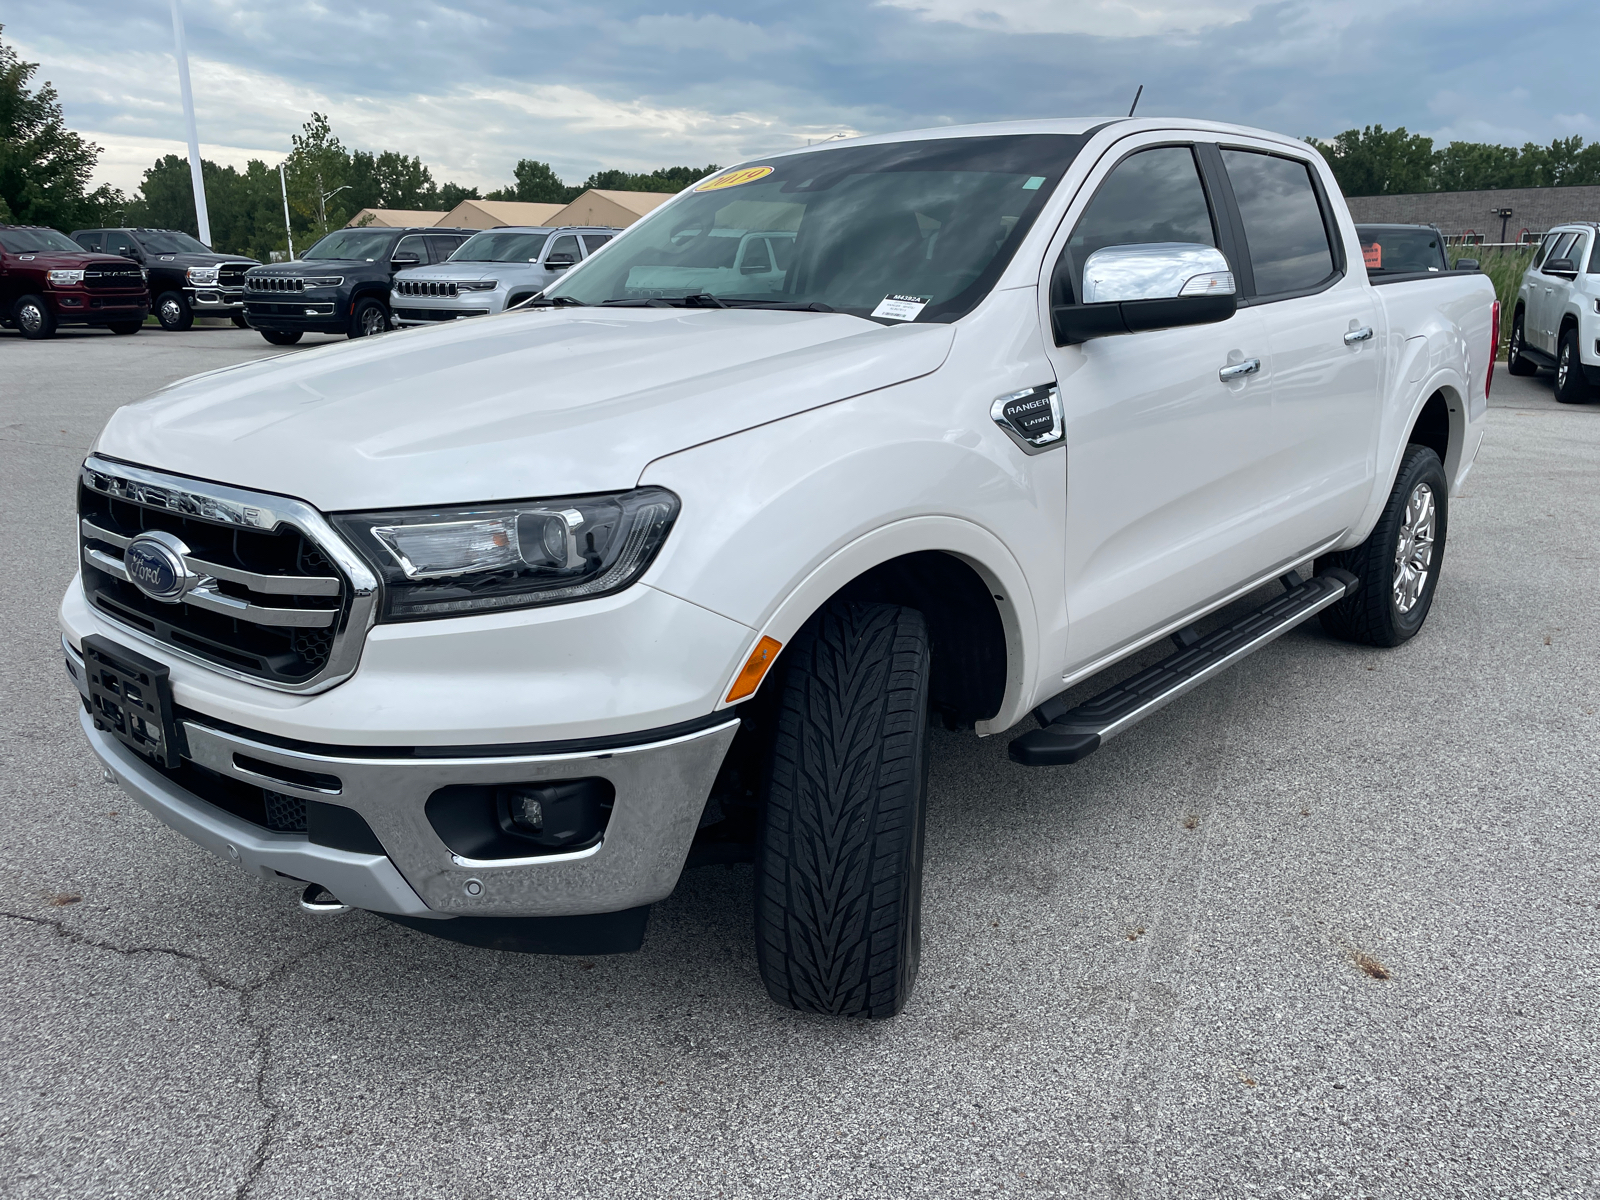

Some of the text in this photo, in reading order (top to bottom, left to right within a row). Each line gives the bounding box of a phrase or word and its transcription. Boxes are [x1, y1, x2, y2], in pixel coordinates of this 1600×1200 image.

[701, 168, 767, 190] 2019
[1006, 398, 1050, 415] RANGER
[1024, 415, 1051, 427] LARIAT
[130, 549, 162, 585] Ford
